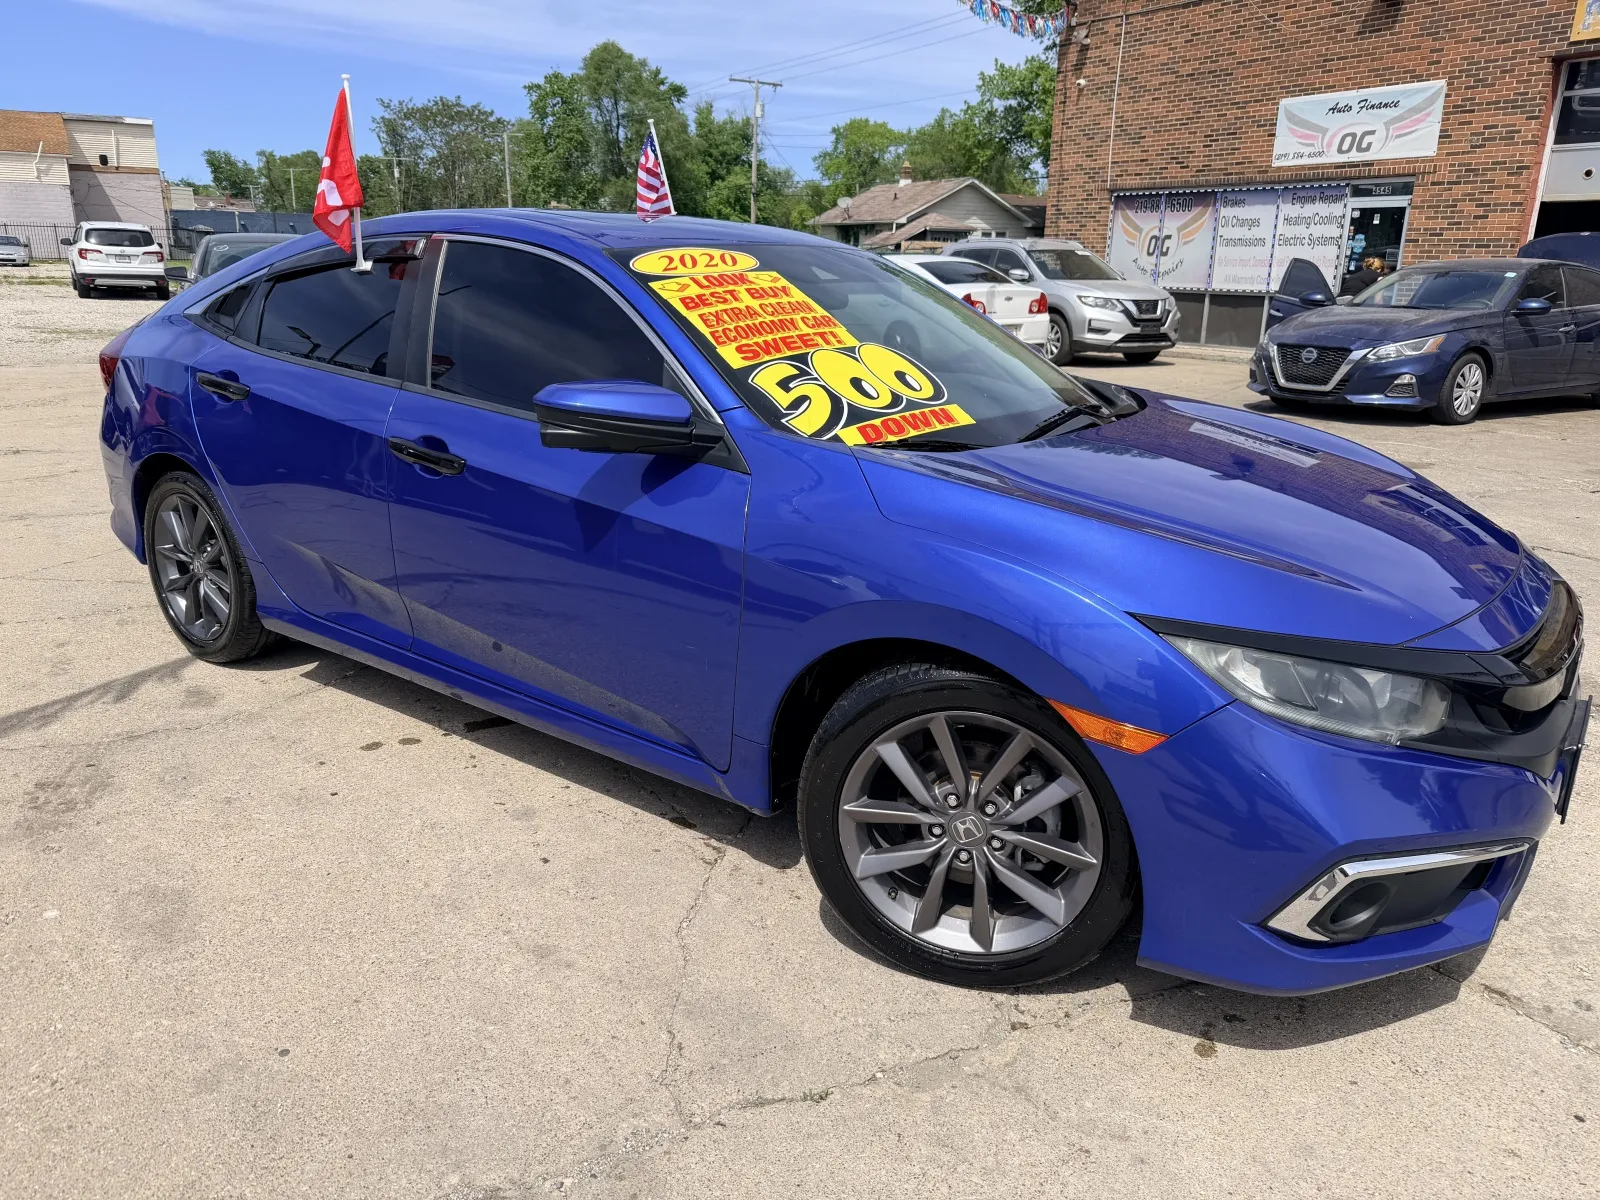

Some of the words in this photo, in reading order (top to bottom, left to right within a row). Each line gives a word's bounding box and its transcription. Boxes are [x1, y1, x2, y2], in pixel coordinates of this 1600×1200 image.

[1325, 101, 1353, 116] Auto
[1356, 98, 1400, 114] Finance
[1336, 129, 1376, 155] OG
[1292, 150, 1325, 160] 884-6500
[1222, 196, 1246, 209] Brakes
[1291, 192, 1317, 208] Engine
[1318, 190, 1345, 208] Repair
[1220, 216, 1230, 228] Oil
[1231, 215, 1261, 230] Changes
[1283, 212, 1342, 229] Heating/Cooling
[1219, 234, 1266, 248] Transmissions
[1278, 234, 1306, 247] Electric
[1307, 233, 1340, 249] Systems
[658, 252, 738, 272] 2020
[1132, 257, 1149, 275] Auto
[689, 272, 756, 290] LOOK
[678, 288, 744, 312] BEST
[747, 285, 793, 301] BUY
[698, 304, 762, 329] EXTRA
[761, 300, 819, 318] CLEAN
[708, 318, 801, 347] ECONOMY
[801, 314, 841, 330] CAR
[734, 330, 847, 362] SWEET!
[748, 342, 948, 440] 500
[856, 407, 960, 444] DOWN
